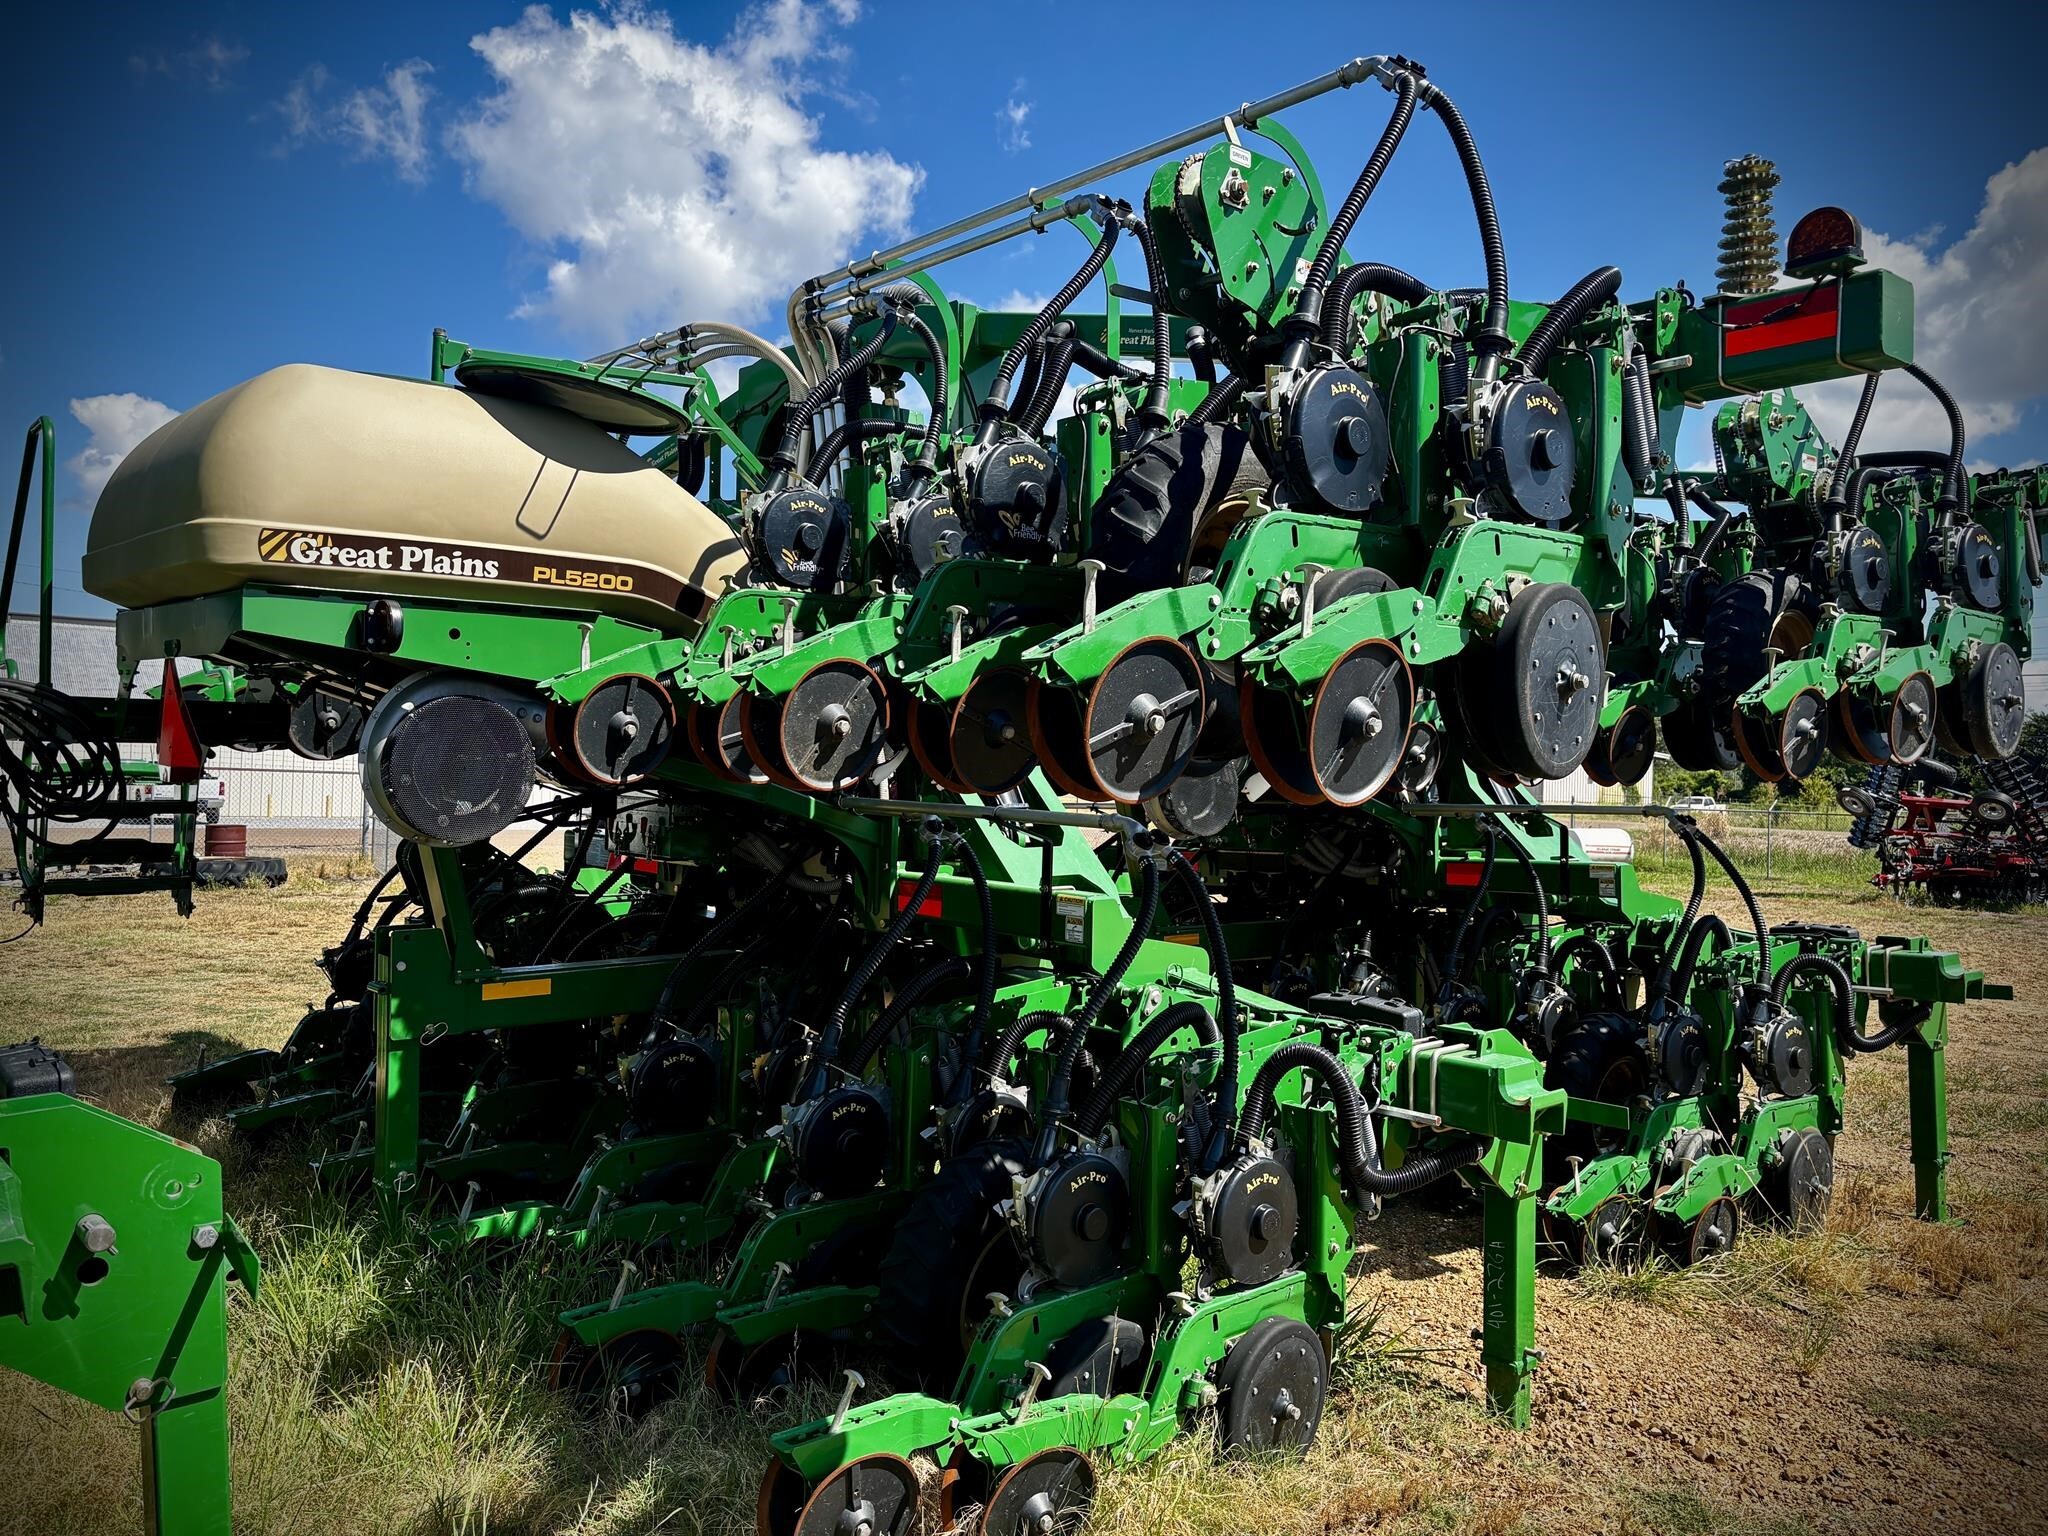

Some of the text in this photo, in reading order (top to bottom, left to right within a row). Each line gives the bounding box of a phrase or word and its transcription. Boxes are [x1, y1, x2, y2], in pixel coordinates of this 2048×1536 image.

[1119, 333, 1139, 345] reat
[1014, 528, 1041, 542] Friendly
[290, 536, 633, 591] Great Plains PL5200
